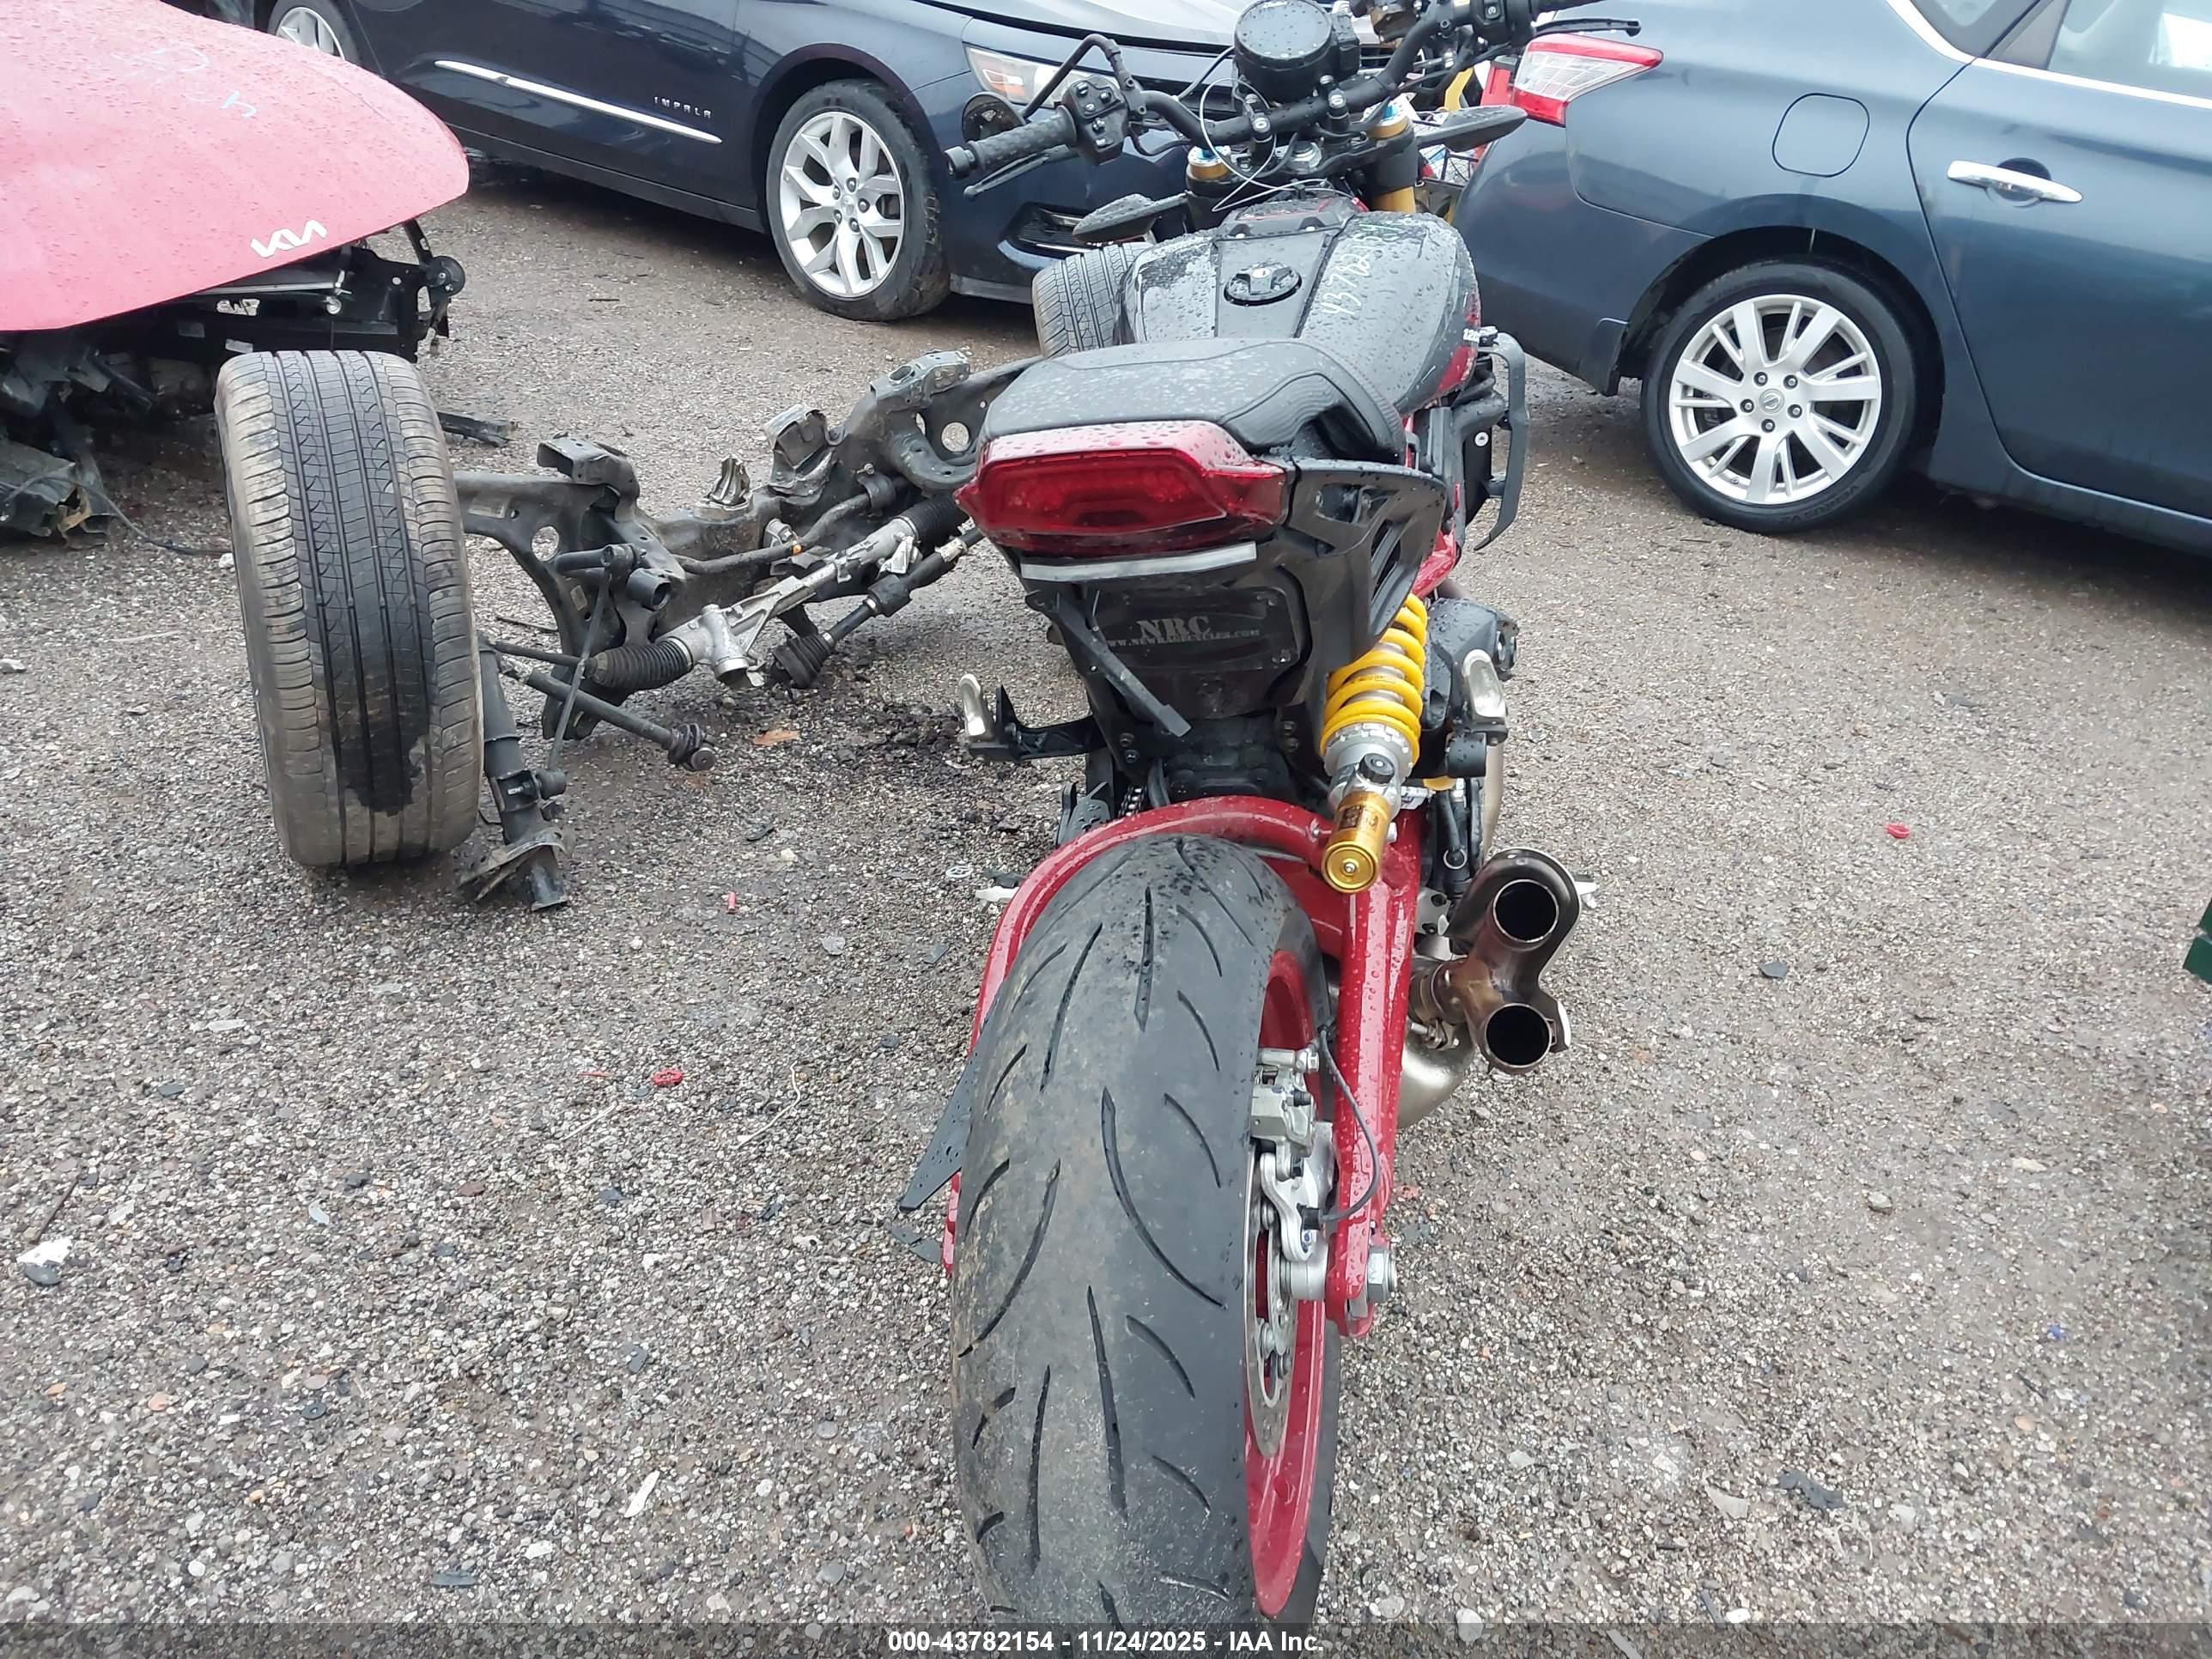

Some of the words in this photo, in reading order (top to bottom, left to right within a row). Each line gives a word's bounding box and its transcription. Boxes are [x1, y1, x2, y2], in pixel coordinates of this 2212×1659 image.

[653, 96, 711, 118] IMPALA
[250, 219, 327, 258] KIA
[1136, 616, 1211, 641] NRC
